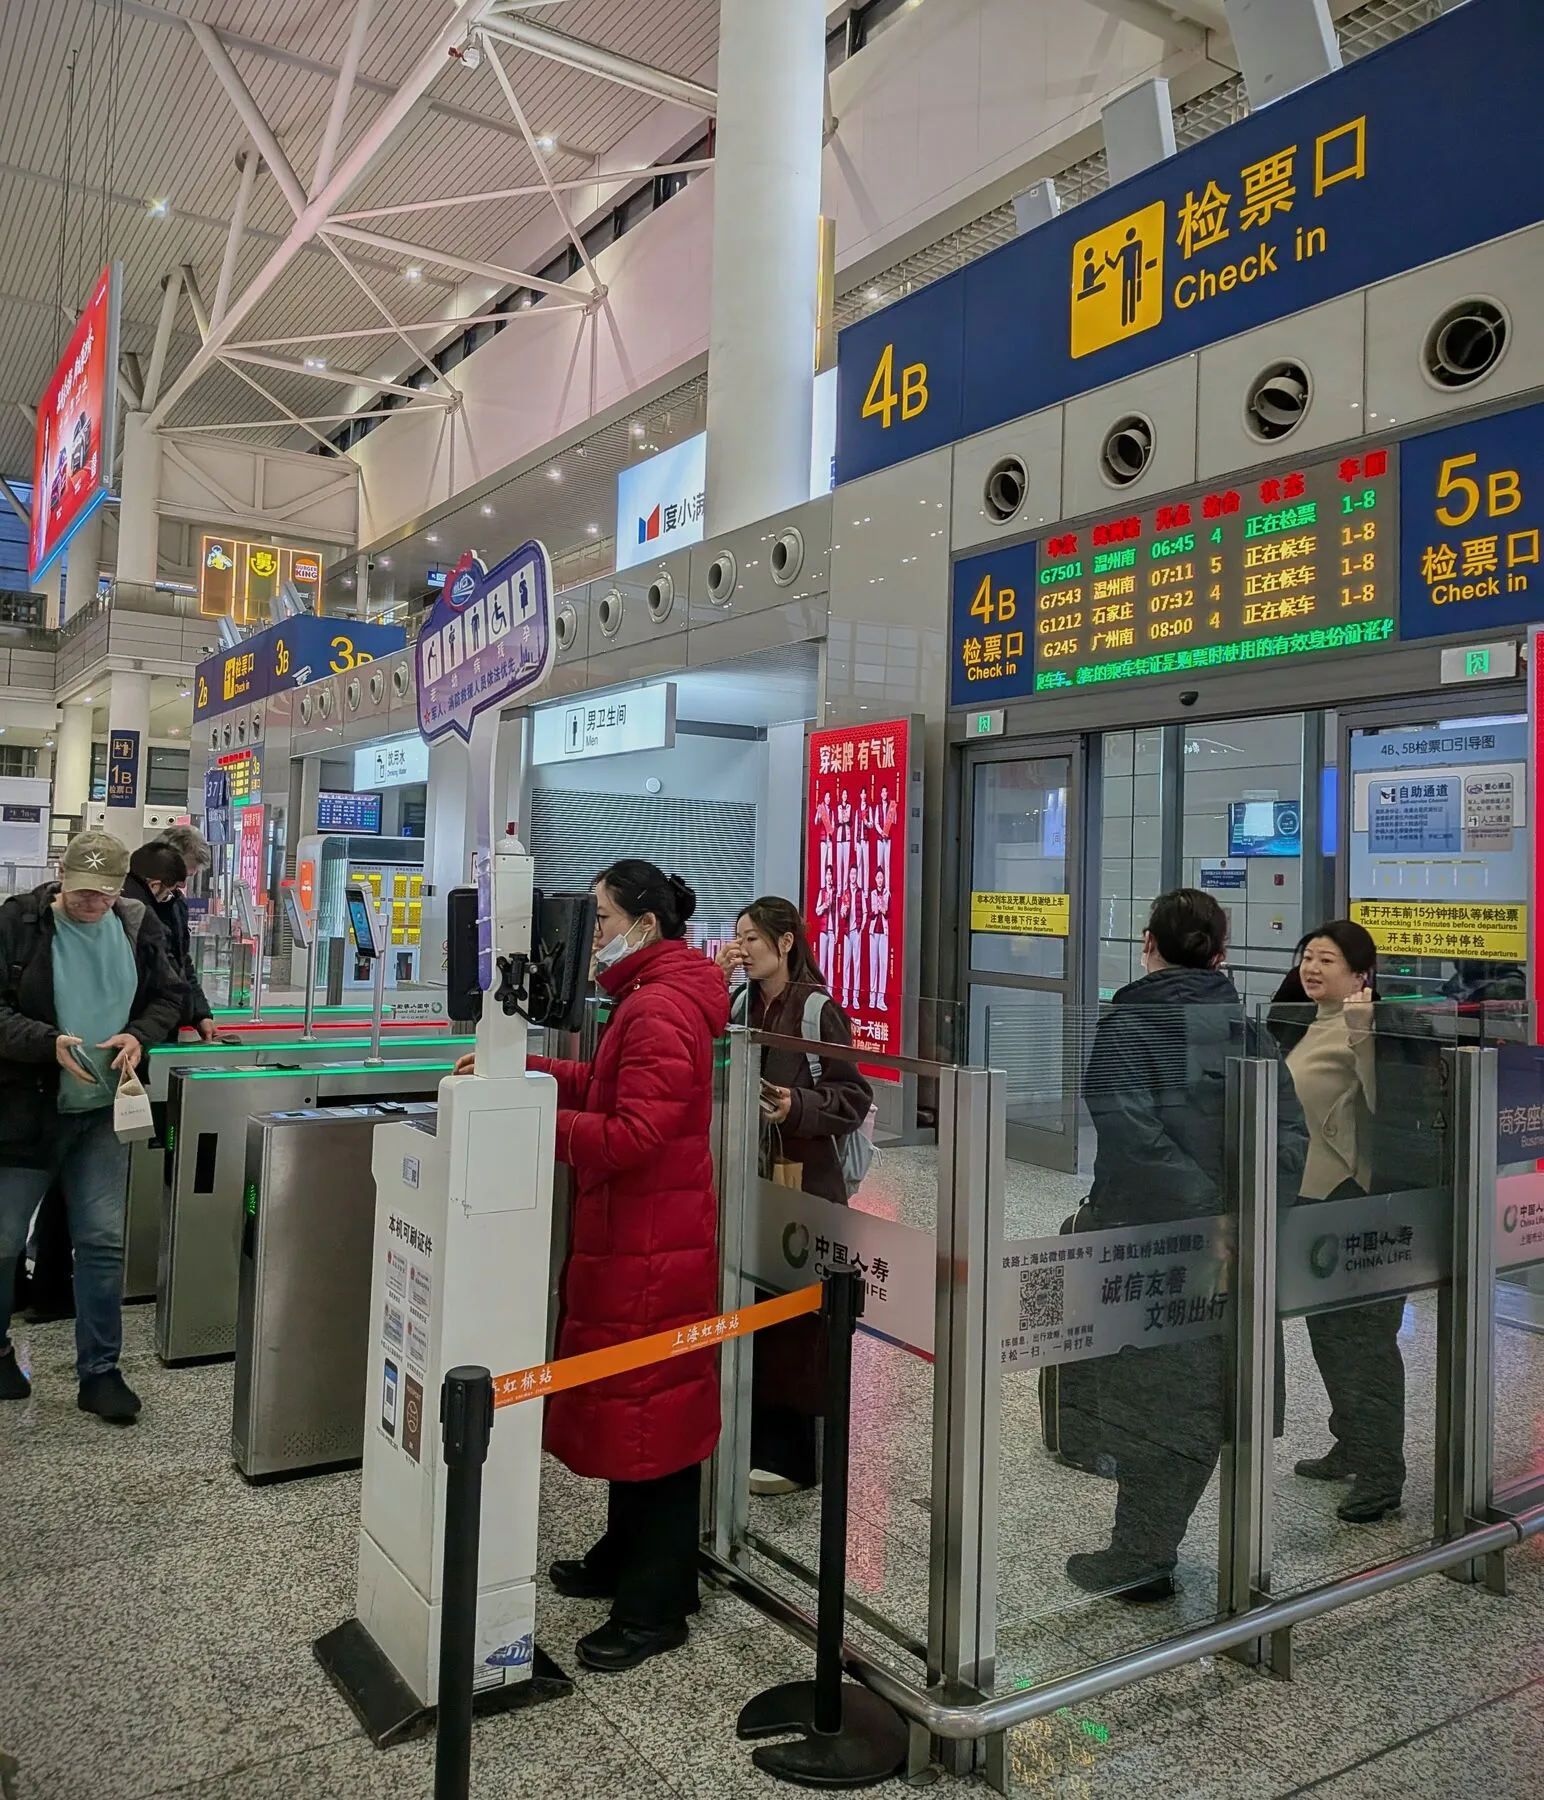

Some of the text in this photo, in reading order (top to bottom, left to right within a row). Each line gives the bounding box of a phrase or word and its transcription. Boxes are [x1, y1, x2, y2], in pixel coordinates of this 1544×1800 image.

[1175, 115, 1367, 260] 检票口
[1173, 227, 1327, 311] Check in
[861, 344, 929, 429] 4B
[1260, 473, 1305, 503] 状态
[1436, 453, 1523, 527] 5B
[1041, 489, 1376, 584] G7501 温州南 06:45 4 正在检票 1-8
[1040, 522, 1375, 610] G7543 温州南 07:11 5 正在候车 1-8
[1421, 529, 1541, 586] 检票口
[295, 570, 318, 579] KING
[1431, 573, 1528, 605] Check in
[970, 574, 1017, 624] 4B
[1040, 554, 1375, 634] G1212 石家庄 07:32 4 正在候车 1-8
[1043, 585, 1375, 658] G245 广州南 08:00 4 正在候车 1-8
[275, 639, 290, 676] 3B
[962, 631, 1024, 666] 检票口
[967, 661, 1017, 681] Check in
[197, 676, 208, 708] 2B
[586, 704, 627, 731] 男卫生间
[819, 736, 895, 774] 穿柒牌 有气派
[1381, 735, 1496, 756] 4B、5B检票口引导图
[111, 764, 132, 784] 1B
[1400, 784, 1449, 798] 自助通道
[990, 914, 1047, 926] 注意电梯下行安全
[1360, 906, 1519, 922] 请于开车前15分钟排队等候检票
[1381, 920, 1412, 928] checking
[1477, 922, 1518, 930] departures
[1387, 932, 1485, 948] 开车前3分钟停检
[1393, 946, 1422, 954] checking
[1476, 950, 1518, 958] departures
[388, 1213, 433, 1258] 本机可刷证件
[1346, 1225, 1414, 1256] 中国人寿
[815, 1235, 889, 1283] 中国人寿
[1002, 1246, 1093, 1269] 铁路上海站微信服务号
[1345, 1249, 1413, 1271] CHINA LIFE
[866, 1282, 888, 1301] IFE
[1101, 1266, 1187, 1305] 诚信友善
[1144, 1292, 1229, 1331] 文明出行
[671, 1314, 740, 1347] 上海虹桥站
